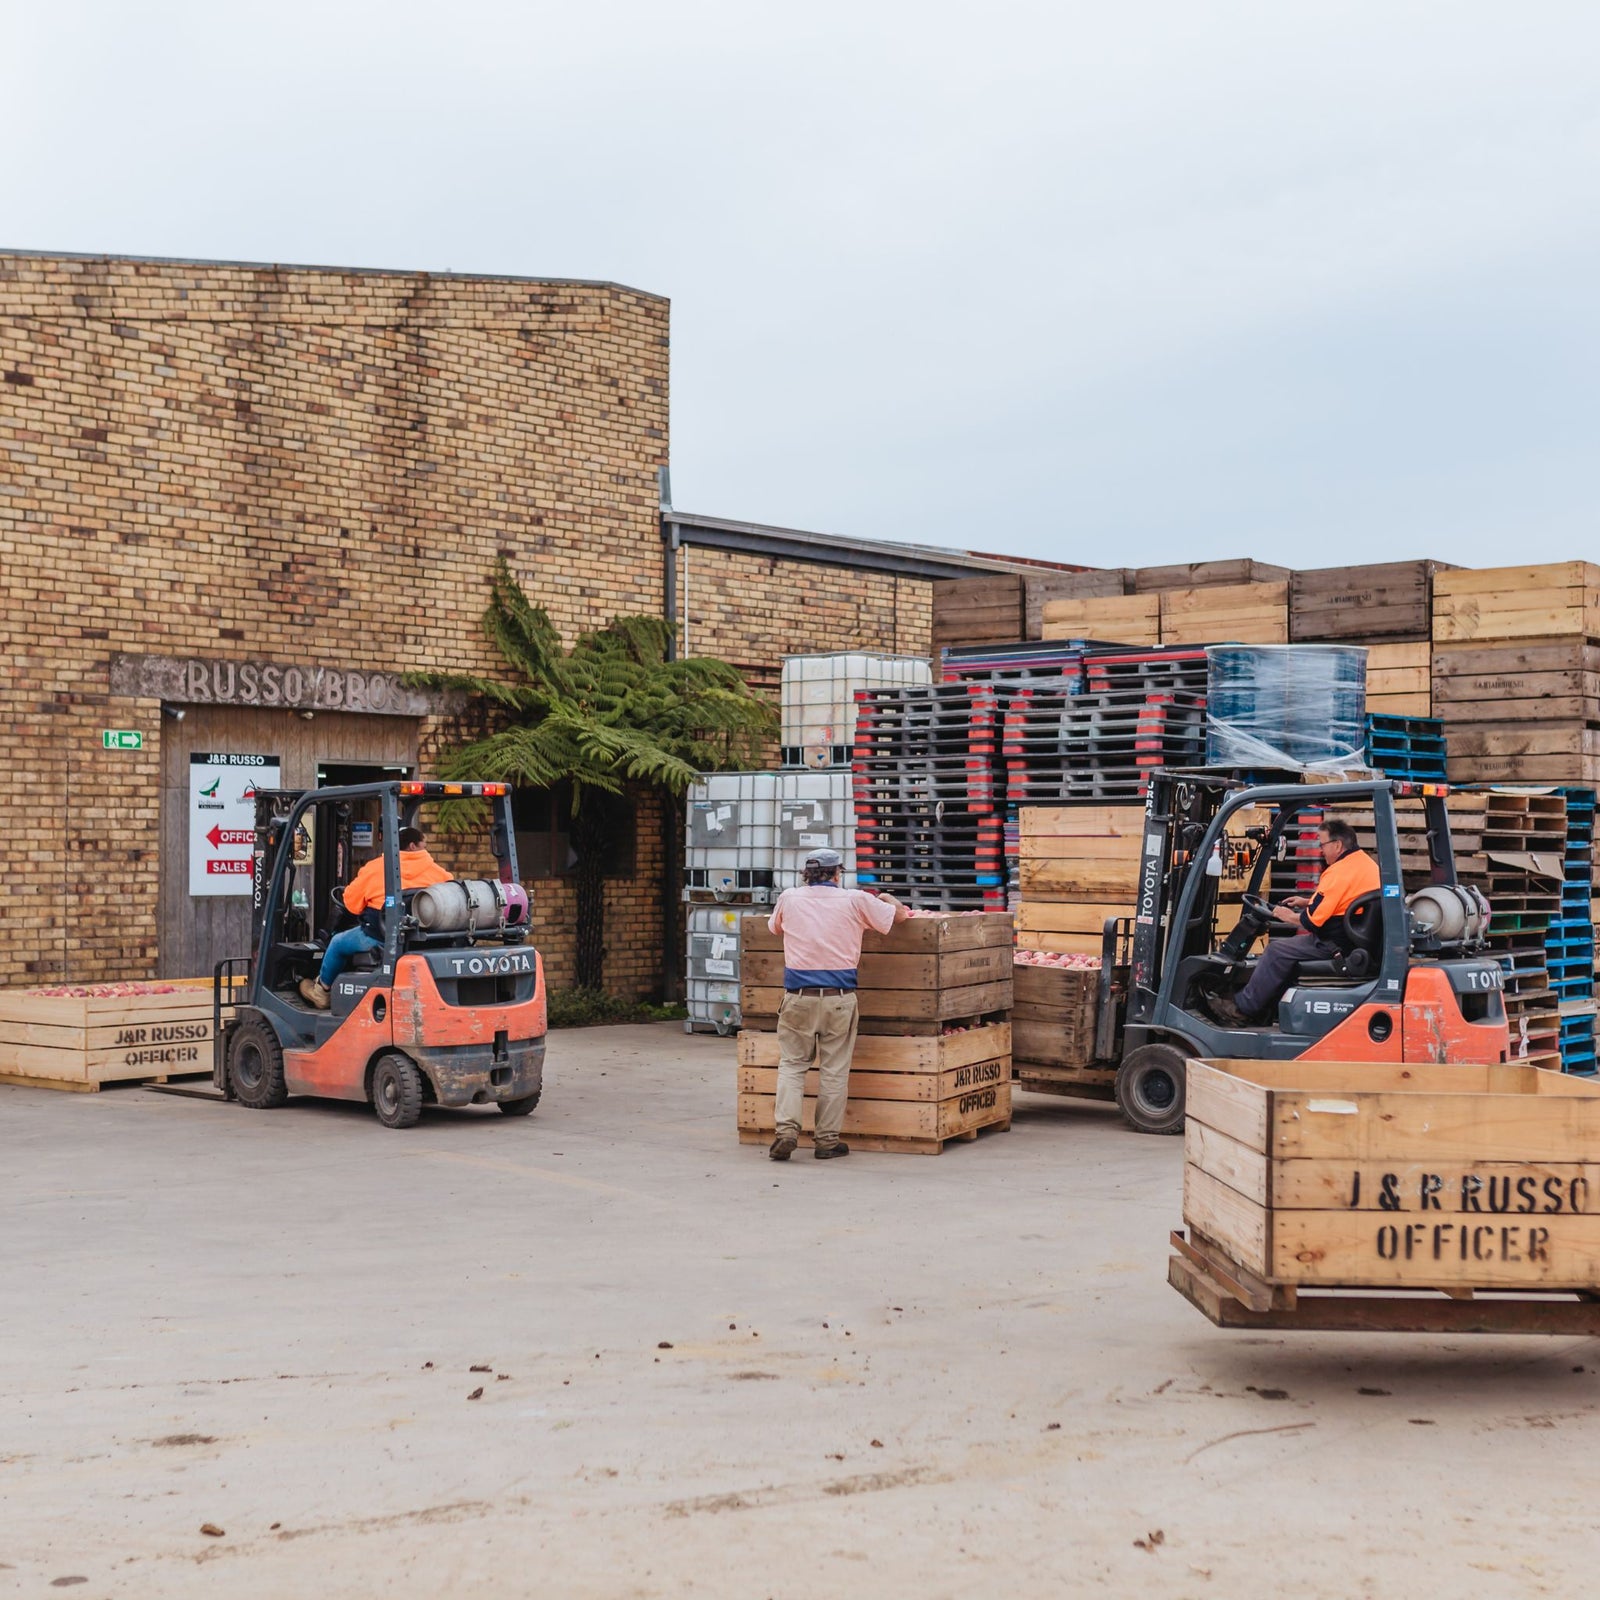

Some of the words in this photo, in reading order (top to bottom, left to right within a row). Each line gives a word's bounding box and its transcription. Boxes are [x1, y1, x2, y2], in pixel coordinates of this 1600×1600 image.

[185, 660, 303, 704] RUSSO
[324, 669, 407, 710] BROS
[207, 754, 227, 764] J&R
[230, 755, 265, 766] RUSSO
[221, 832, 254, 842] OFFIC
[212, 862, 247, 873] SALES
[255, 857, 263, 909] TOYOTA
[1142, 859, 1157, 917] TOYOTA
[452, 954, 531, 975] TOYOTA
[339, 983, 354, 995] 18
[1467, 970, 1503, 989] TOYO
[1304, 1001, 1331, 1014] 18
[115, 1029, 146, 1044] J&R
[152, 1024, 208, 1041] RUSSO
[125, 1047, 198, 1066] OFFICER
[954, 1068, 971, 1088] J&R
[973, 1063, 1000, 1084] RUSSO
[960, 1090, 996, 1114] OFFICER
[1349, 1171, 1360, 1208] J
[1378, 1173, 1400, 1211] &
[1421, 1173, 1442, 1210] R
[1461, 1175, 1589, 1213] RUSSO
[1377, 1224, 1549, 1262] OFFICER
